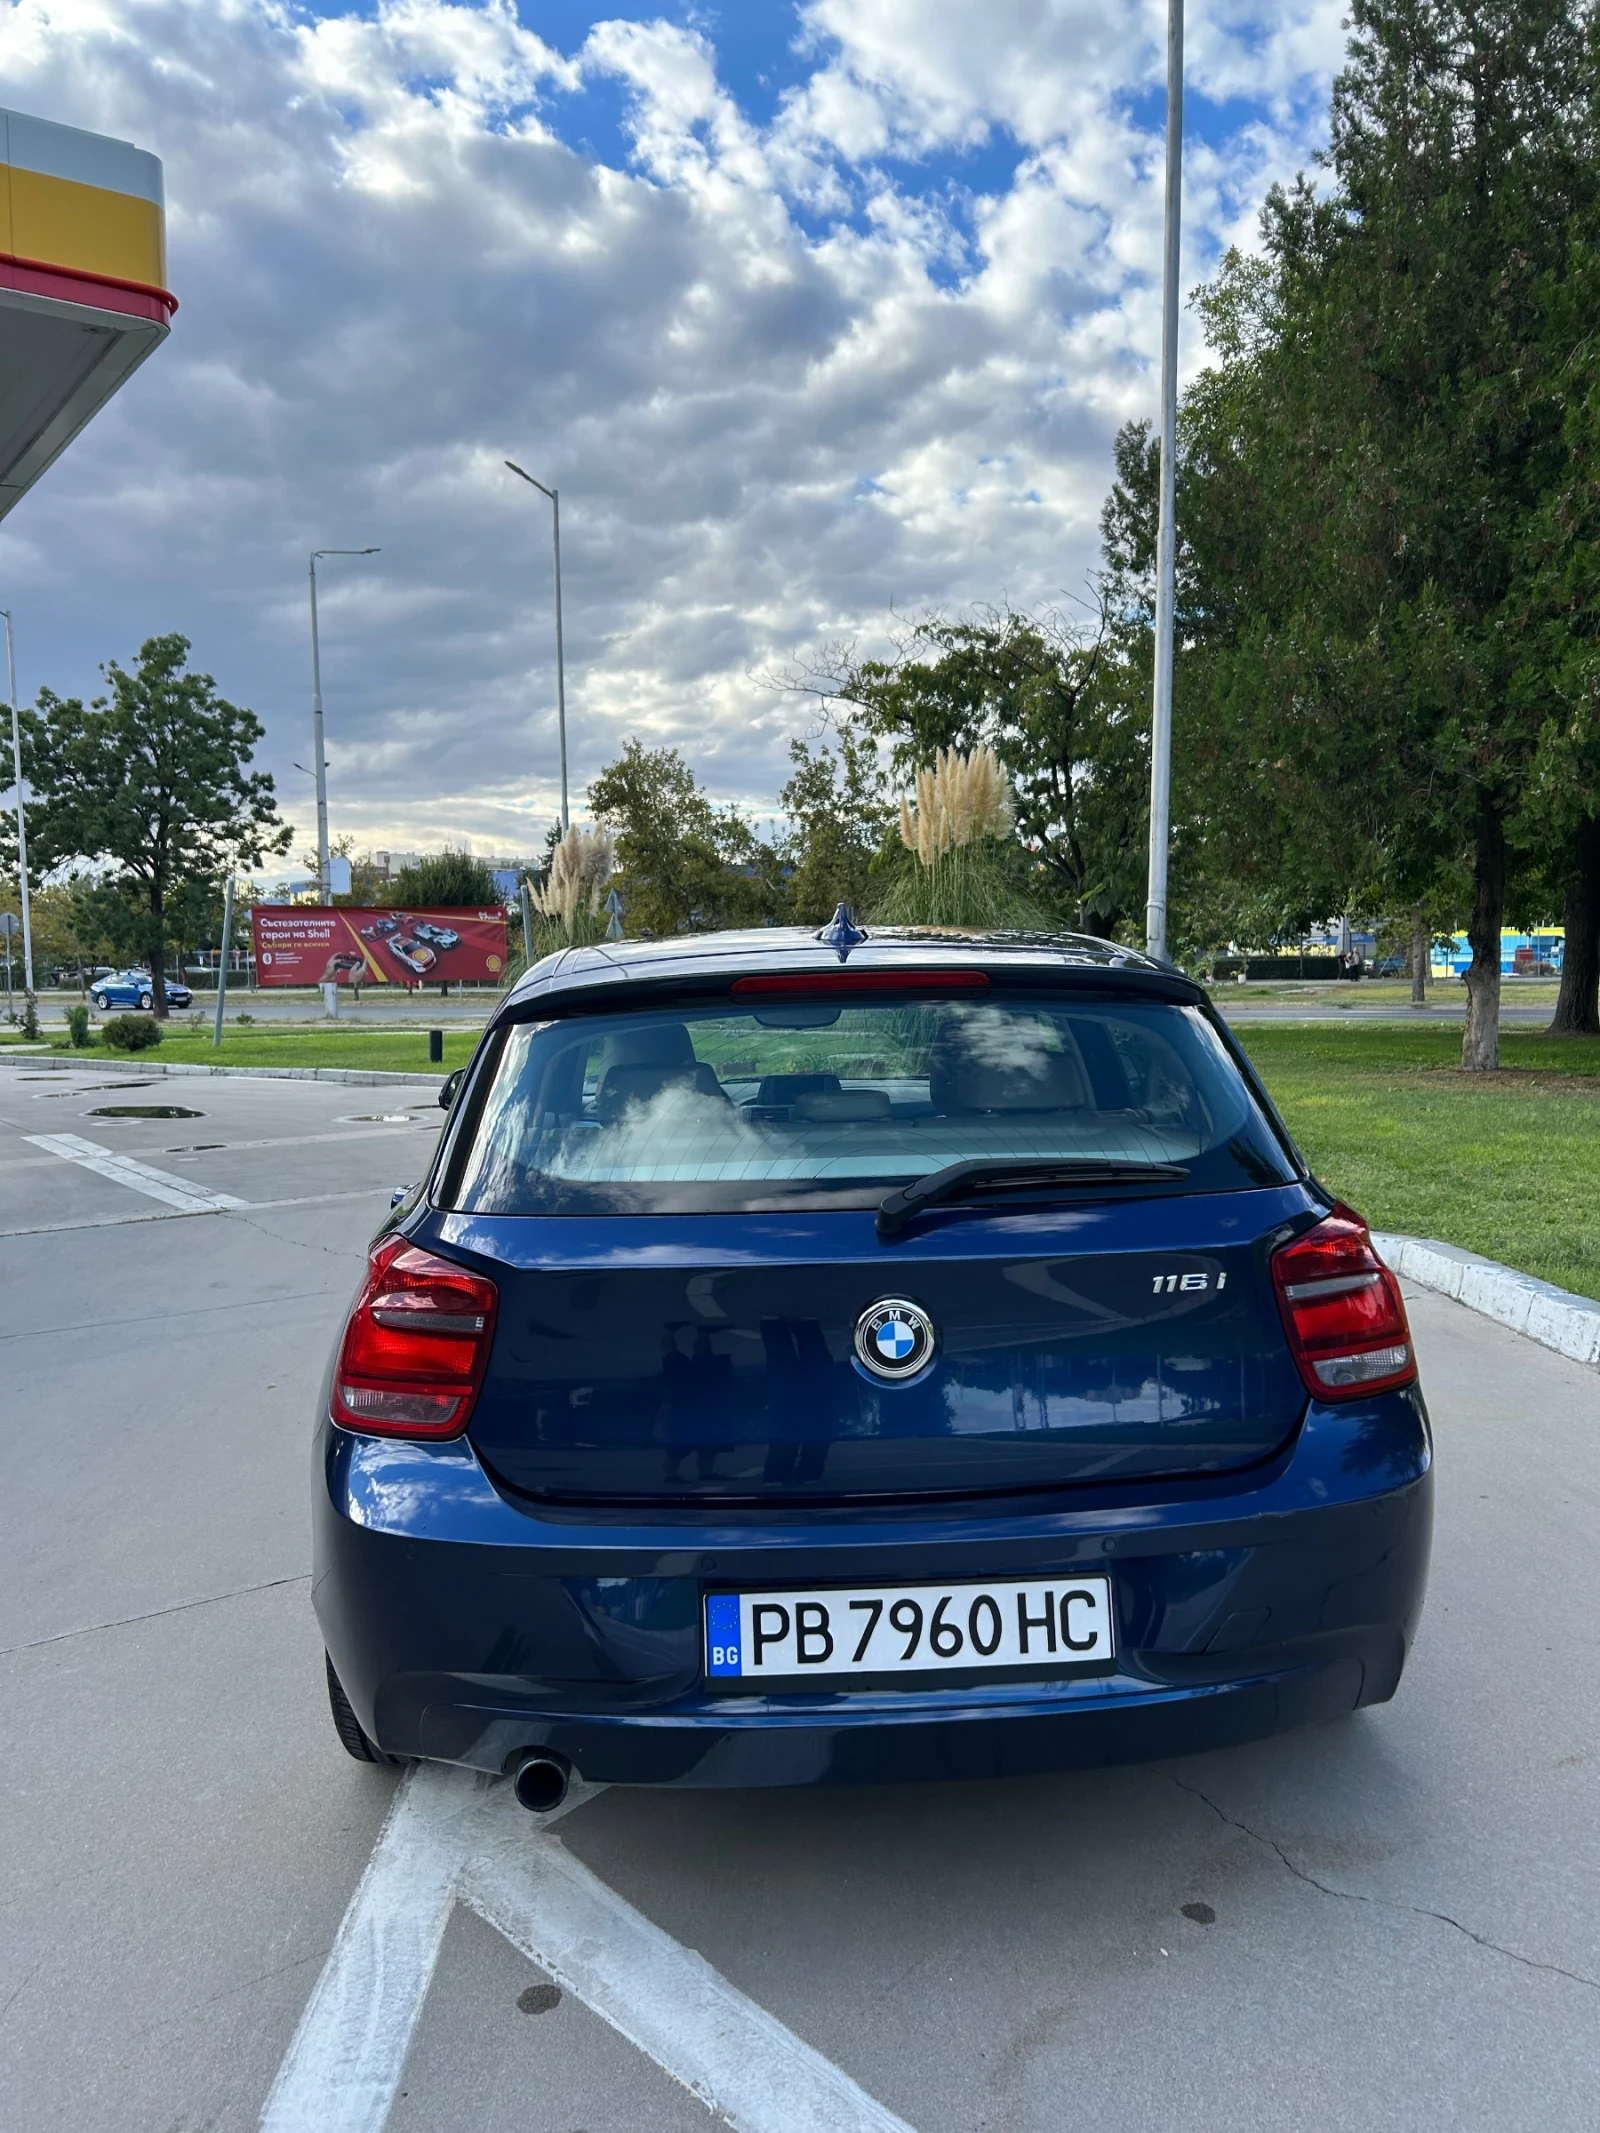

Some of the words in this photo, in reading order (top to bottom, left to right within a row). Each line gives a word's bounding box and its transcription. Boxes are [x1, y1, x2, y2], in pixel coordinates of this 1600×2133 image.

[260, 918, 336, 927] Състезателните
[261, 931, 290, 941] герои
[307, 928, 330, 938] Shell
[870, 1310, 920, 1331] BMW
[752, 1602, 834, 1665] PB
[849, 1594, 1002, 1662] 7960
[1017, 1590, 1098, 1654] HC
[712, 1646, 739, 1666] BG
